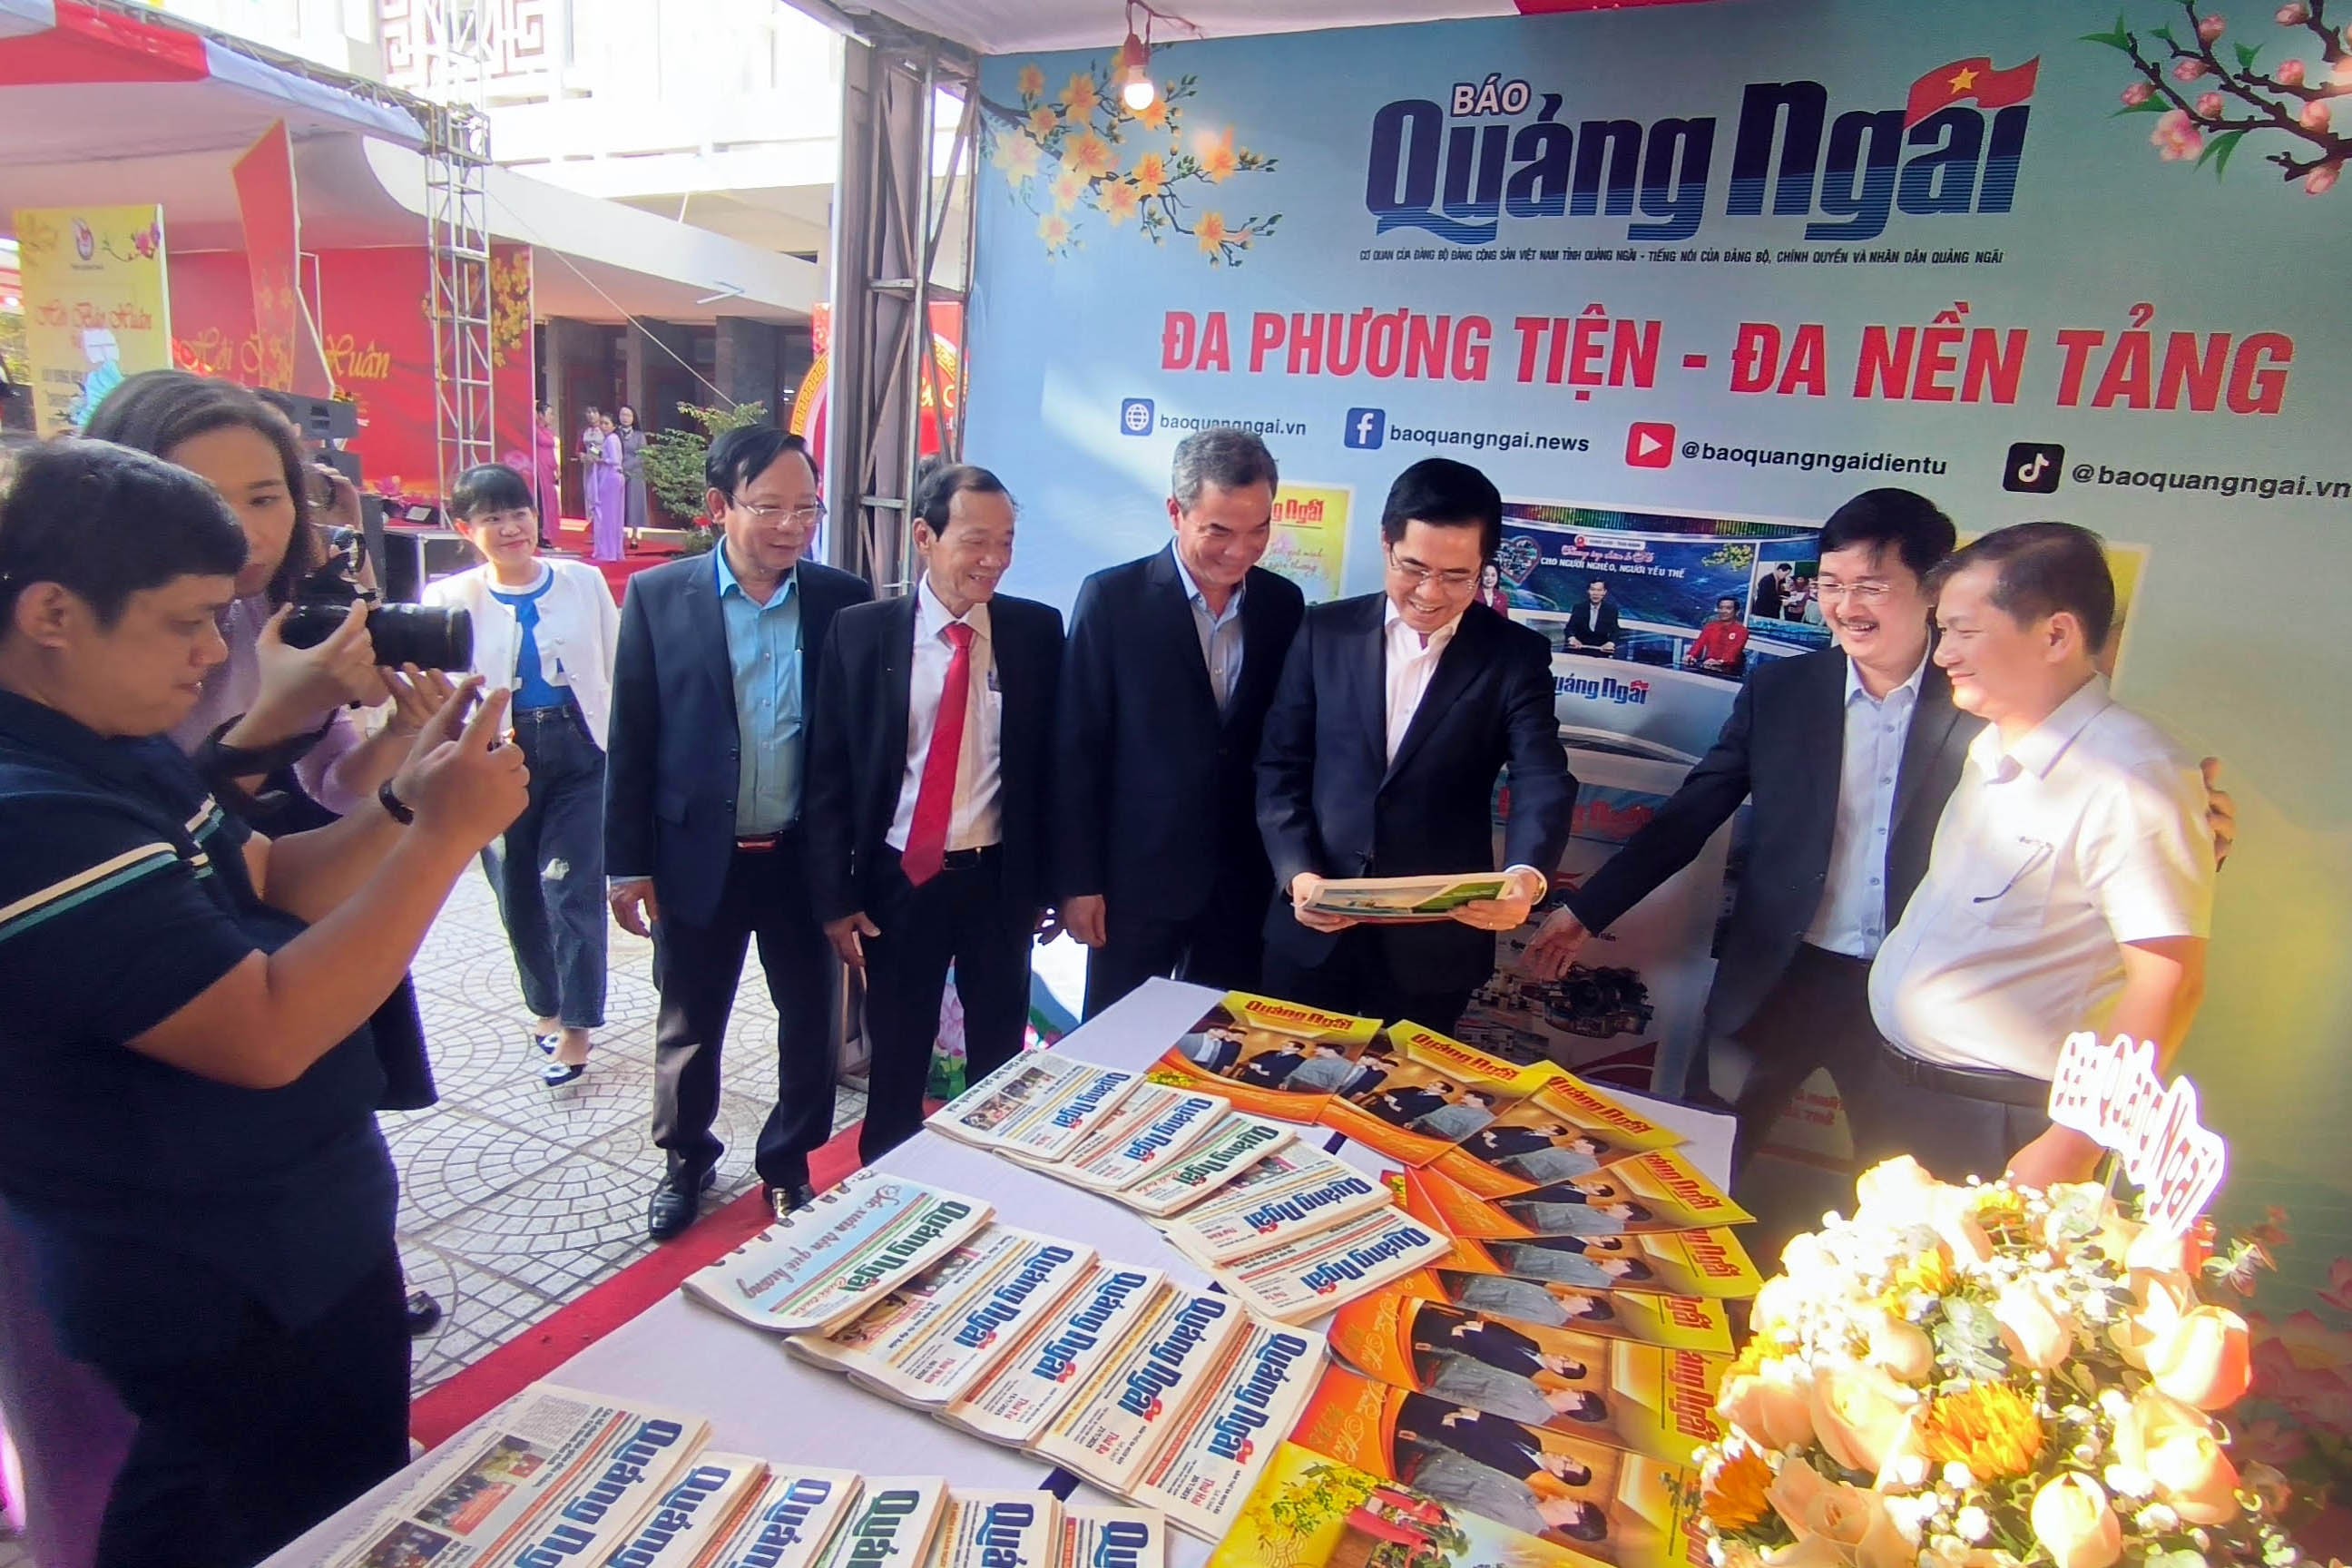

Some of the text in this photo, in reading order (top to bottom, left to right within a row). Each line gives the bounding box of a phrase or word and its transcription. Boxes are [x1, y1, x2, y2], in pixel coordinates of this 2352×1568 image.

[1451, 74, 1530, 118] BÁO
[1365, 60, 2039, 244] Quảng Ngãi
[1648, 248, 1676, 263] TIẾNG
[1681, 248, 1697, 263] NÓI
[1700, 248, 1719, 263] CỦA
[1723, 248, 1751, 263] ĐẢNG
[1756, 248, 1772, 264] BỘ,
[1777, 248, 1808, 263] CHÍNH
[1813, 248, 1847, 263] QUYỀN
[1853, 248, 1867, 263] VÀ
[1869, 248, 1897, 263] NHÂN
[1905, 248, 1926, 263] DÂN
[1932, 248, 1969, 263] QUẢNG
[1975, 248, 2003, 263] NGÃI
[1161, 301, 2295, 415] ĐA PHƯƠNG TIỆN - ĐA NỀN TẢNG
[1390, 423, 1591, 455] baoquangngai.news
[1681, 440, 1947, 476] @baoquangngaidientu
[2072, 464, 2352, 499] @baoquangngai.vn
[1541, 557, 1558, 565] CHO
[1559, 558, 1585, 569] NGƯỜI
[1586, 561, 1617, 573] NGHÈO,
[1619, 564, 1646, 574] NGƯỜI
[1553, 673, 1599, 700] uảng
[1051, 1102, 1095, 1130] Ngãi
[1080, 1073, 1132, 1105] Quảng
[1122, 1102, 1212, 1164] Quảng Ngãi
[1173, 1127, 1279, 1188] Quảng Ngãi
[1243, 1202, 1304, 1235] Ngãi
[1292, 1180, 1372, 1210] Quảng
[887, 1202, 972, 1263] Quảng
[838, 1255, 908, 1294] Ngãi
[992, 1246, 1075, 1308] Quảng
[1300, 1226, 1431, 1297] Quảng Ngãi
[954, 1301, 1021, 1351] Ngãi
[1070, 1272, 1148, 1335] Quảng
[1150, 1298, 1226, 1362] Quảng
[1032, 1331, 1097, 1385] Ngãi
[1235, 1338, 1307, 1404] Quảng
[1668, 1350, 1710, 1387] ảng
[1118, 1358, 1183, 1424] Ngãi
[1208, 1401, 1270, 1466] Ngãi
[561, 1419, 682, 1524] Quảng
[514, 1524, 596, 1568] Ng
[728, 1479, 831, 1568] Quản
[846, 1491, 919, 1568] Quả
[975, 1503, 1034, 1568] Quả
